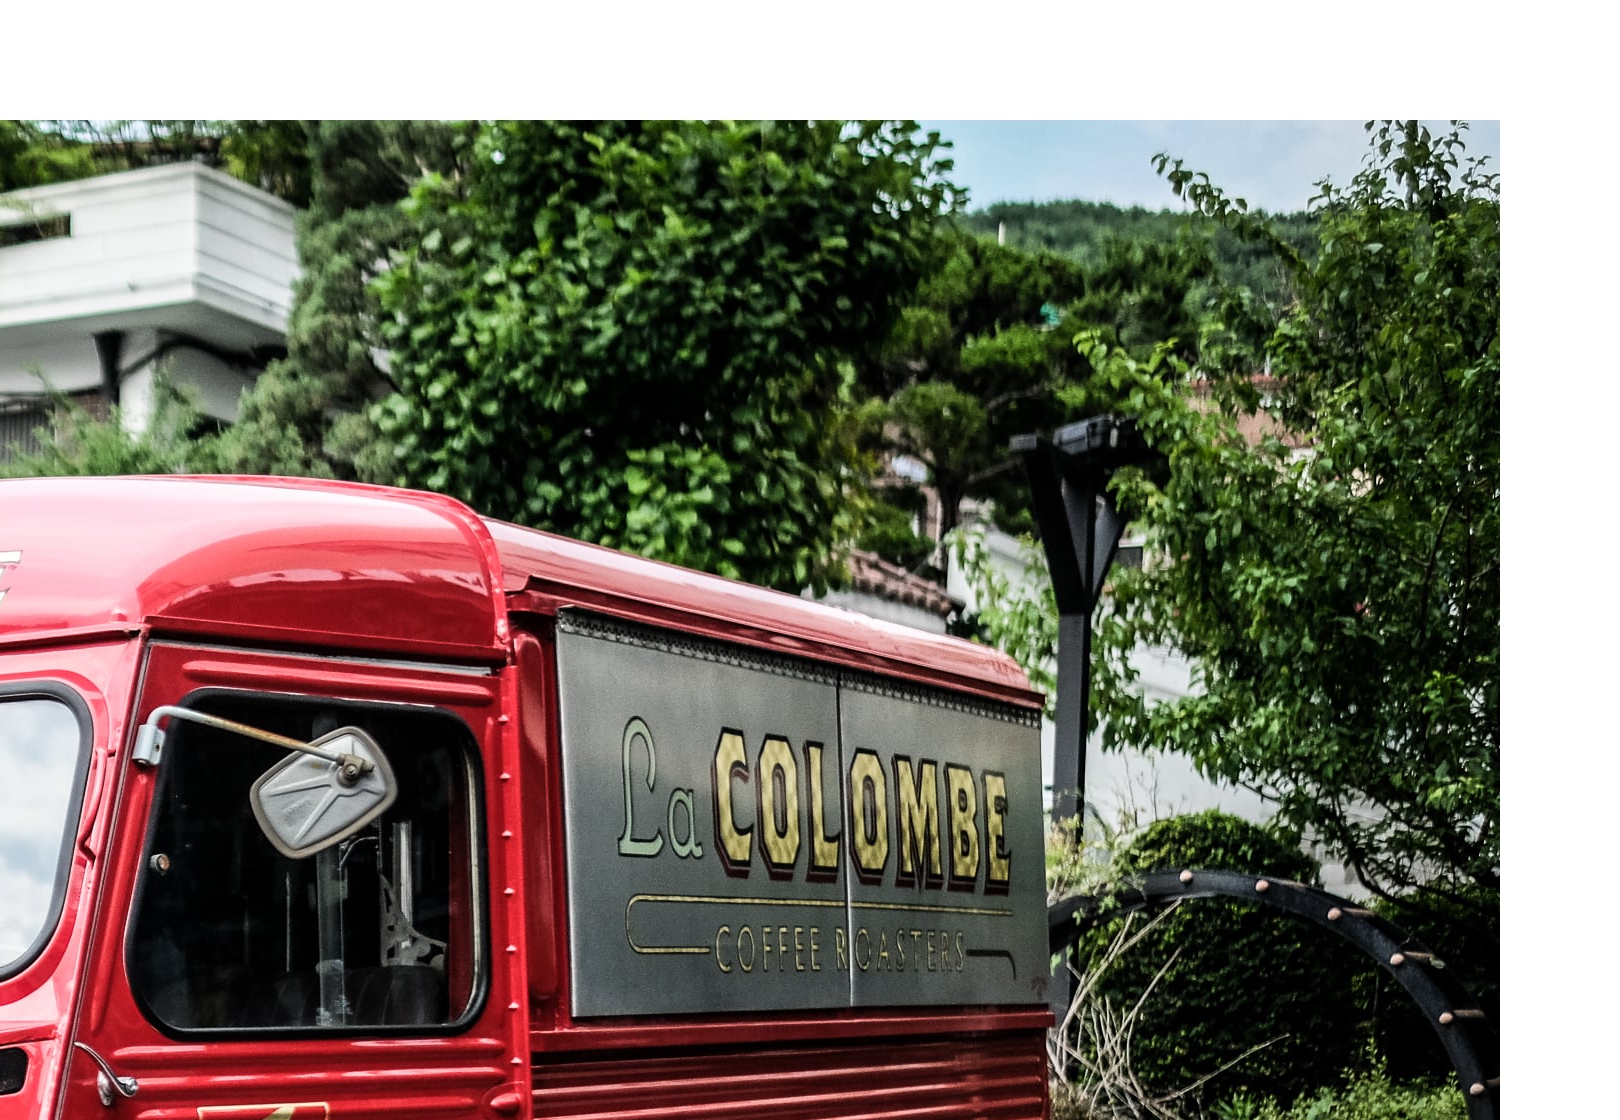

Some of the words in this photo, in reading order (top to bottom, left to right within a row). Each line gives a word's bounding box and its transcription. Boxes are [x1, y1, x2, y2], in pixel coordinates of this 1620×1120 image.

[618, 715, 703, 859] La
[711, 726, 1012, 896] COLOMBE
[714, 925, 821, 974] COFFEE
[835, 926, 965, 974] ROASTERS
